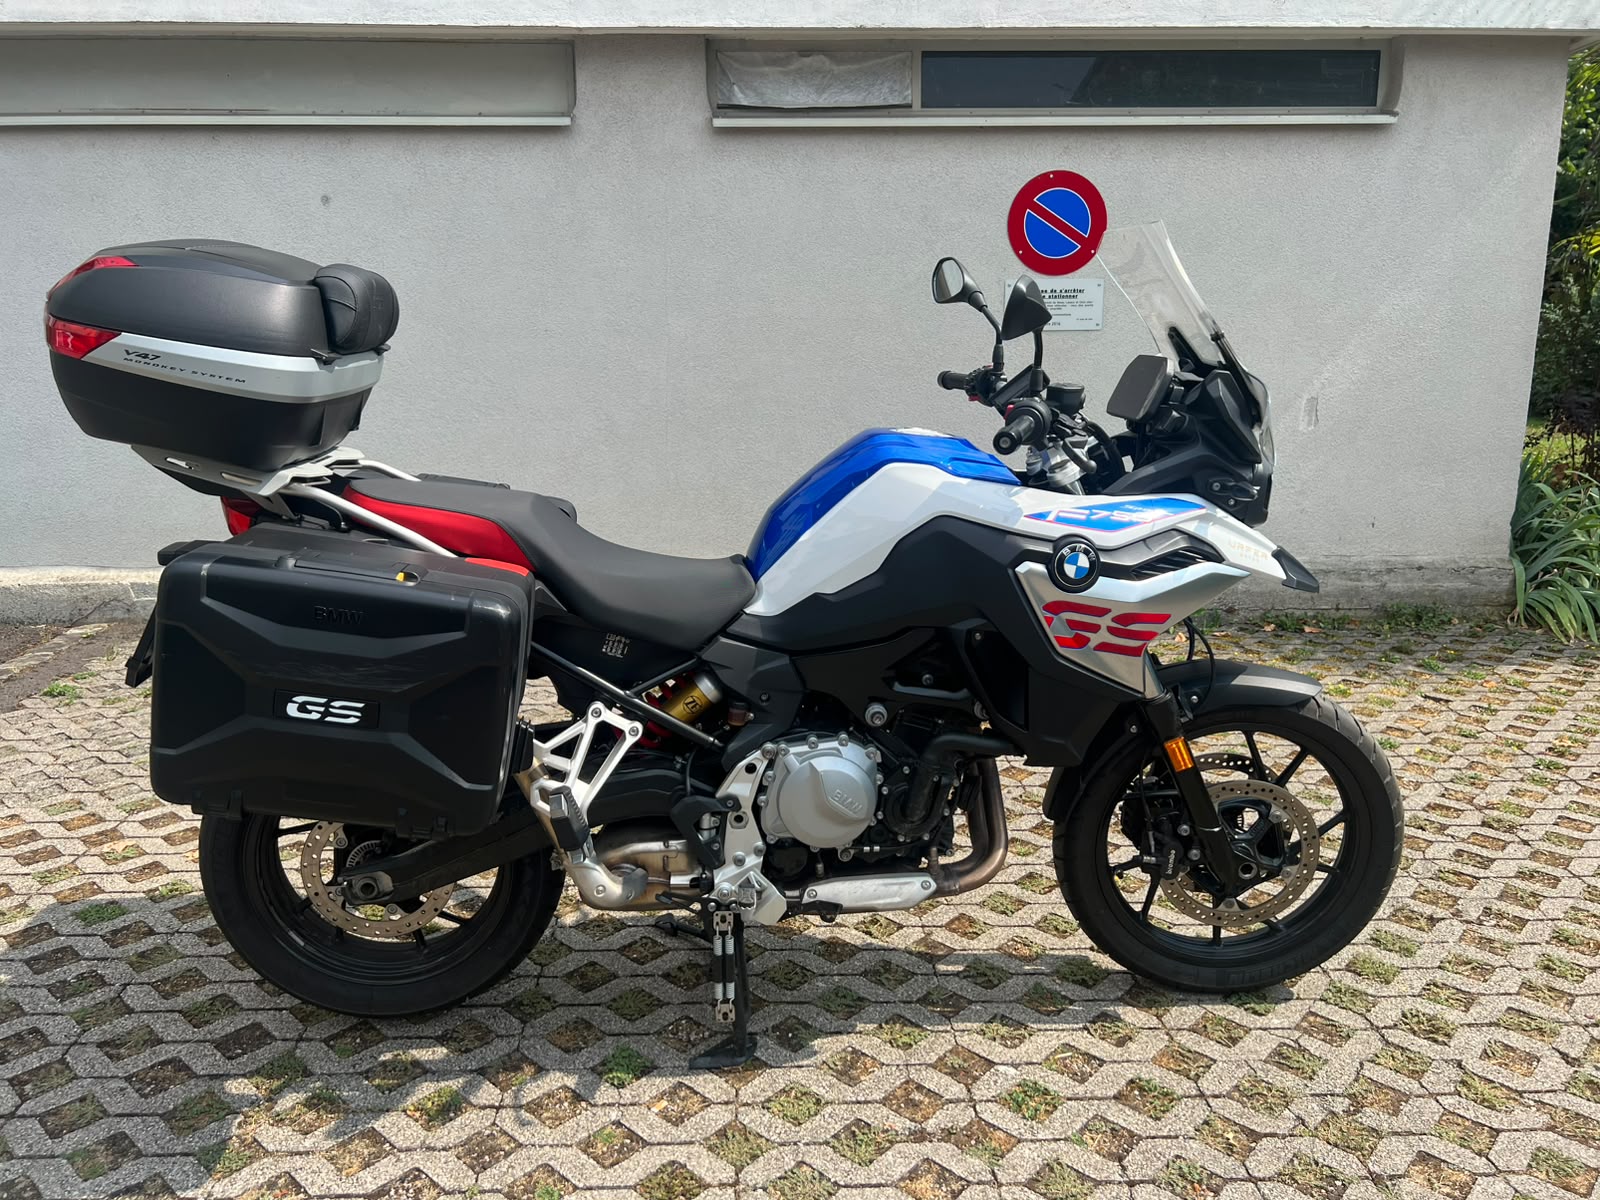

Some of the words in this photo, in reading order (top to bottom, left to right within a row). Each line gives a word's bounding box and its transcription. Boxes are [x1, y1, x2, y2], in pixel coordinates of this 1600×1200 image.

[124, 349, 161, 361] V47
[123, 357, 186, 372] MONOKEY
[191, 370, 246, 383] SYSTEM
[1062, 544, 1096, 561] BMW
[314, 605, 364, 624] BMW
[1042, 600, 1171, 657] GS
[286, 695, 366, 724] GS
[833, 789, 863, 813] BMW
[1165, 849, 1176, 875] brembo
